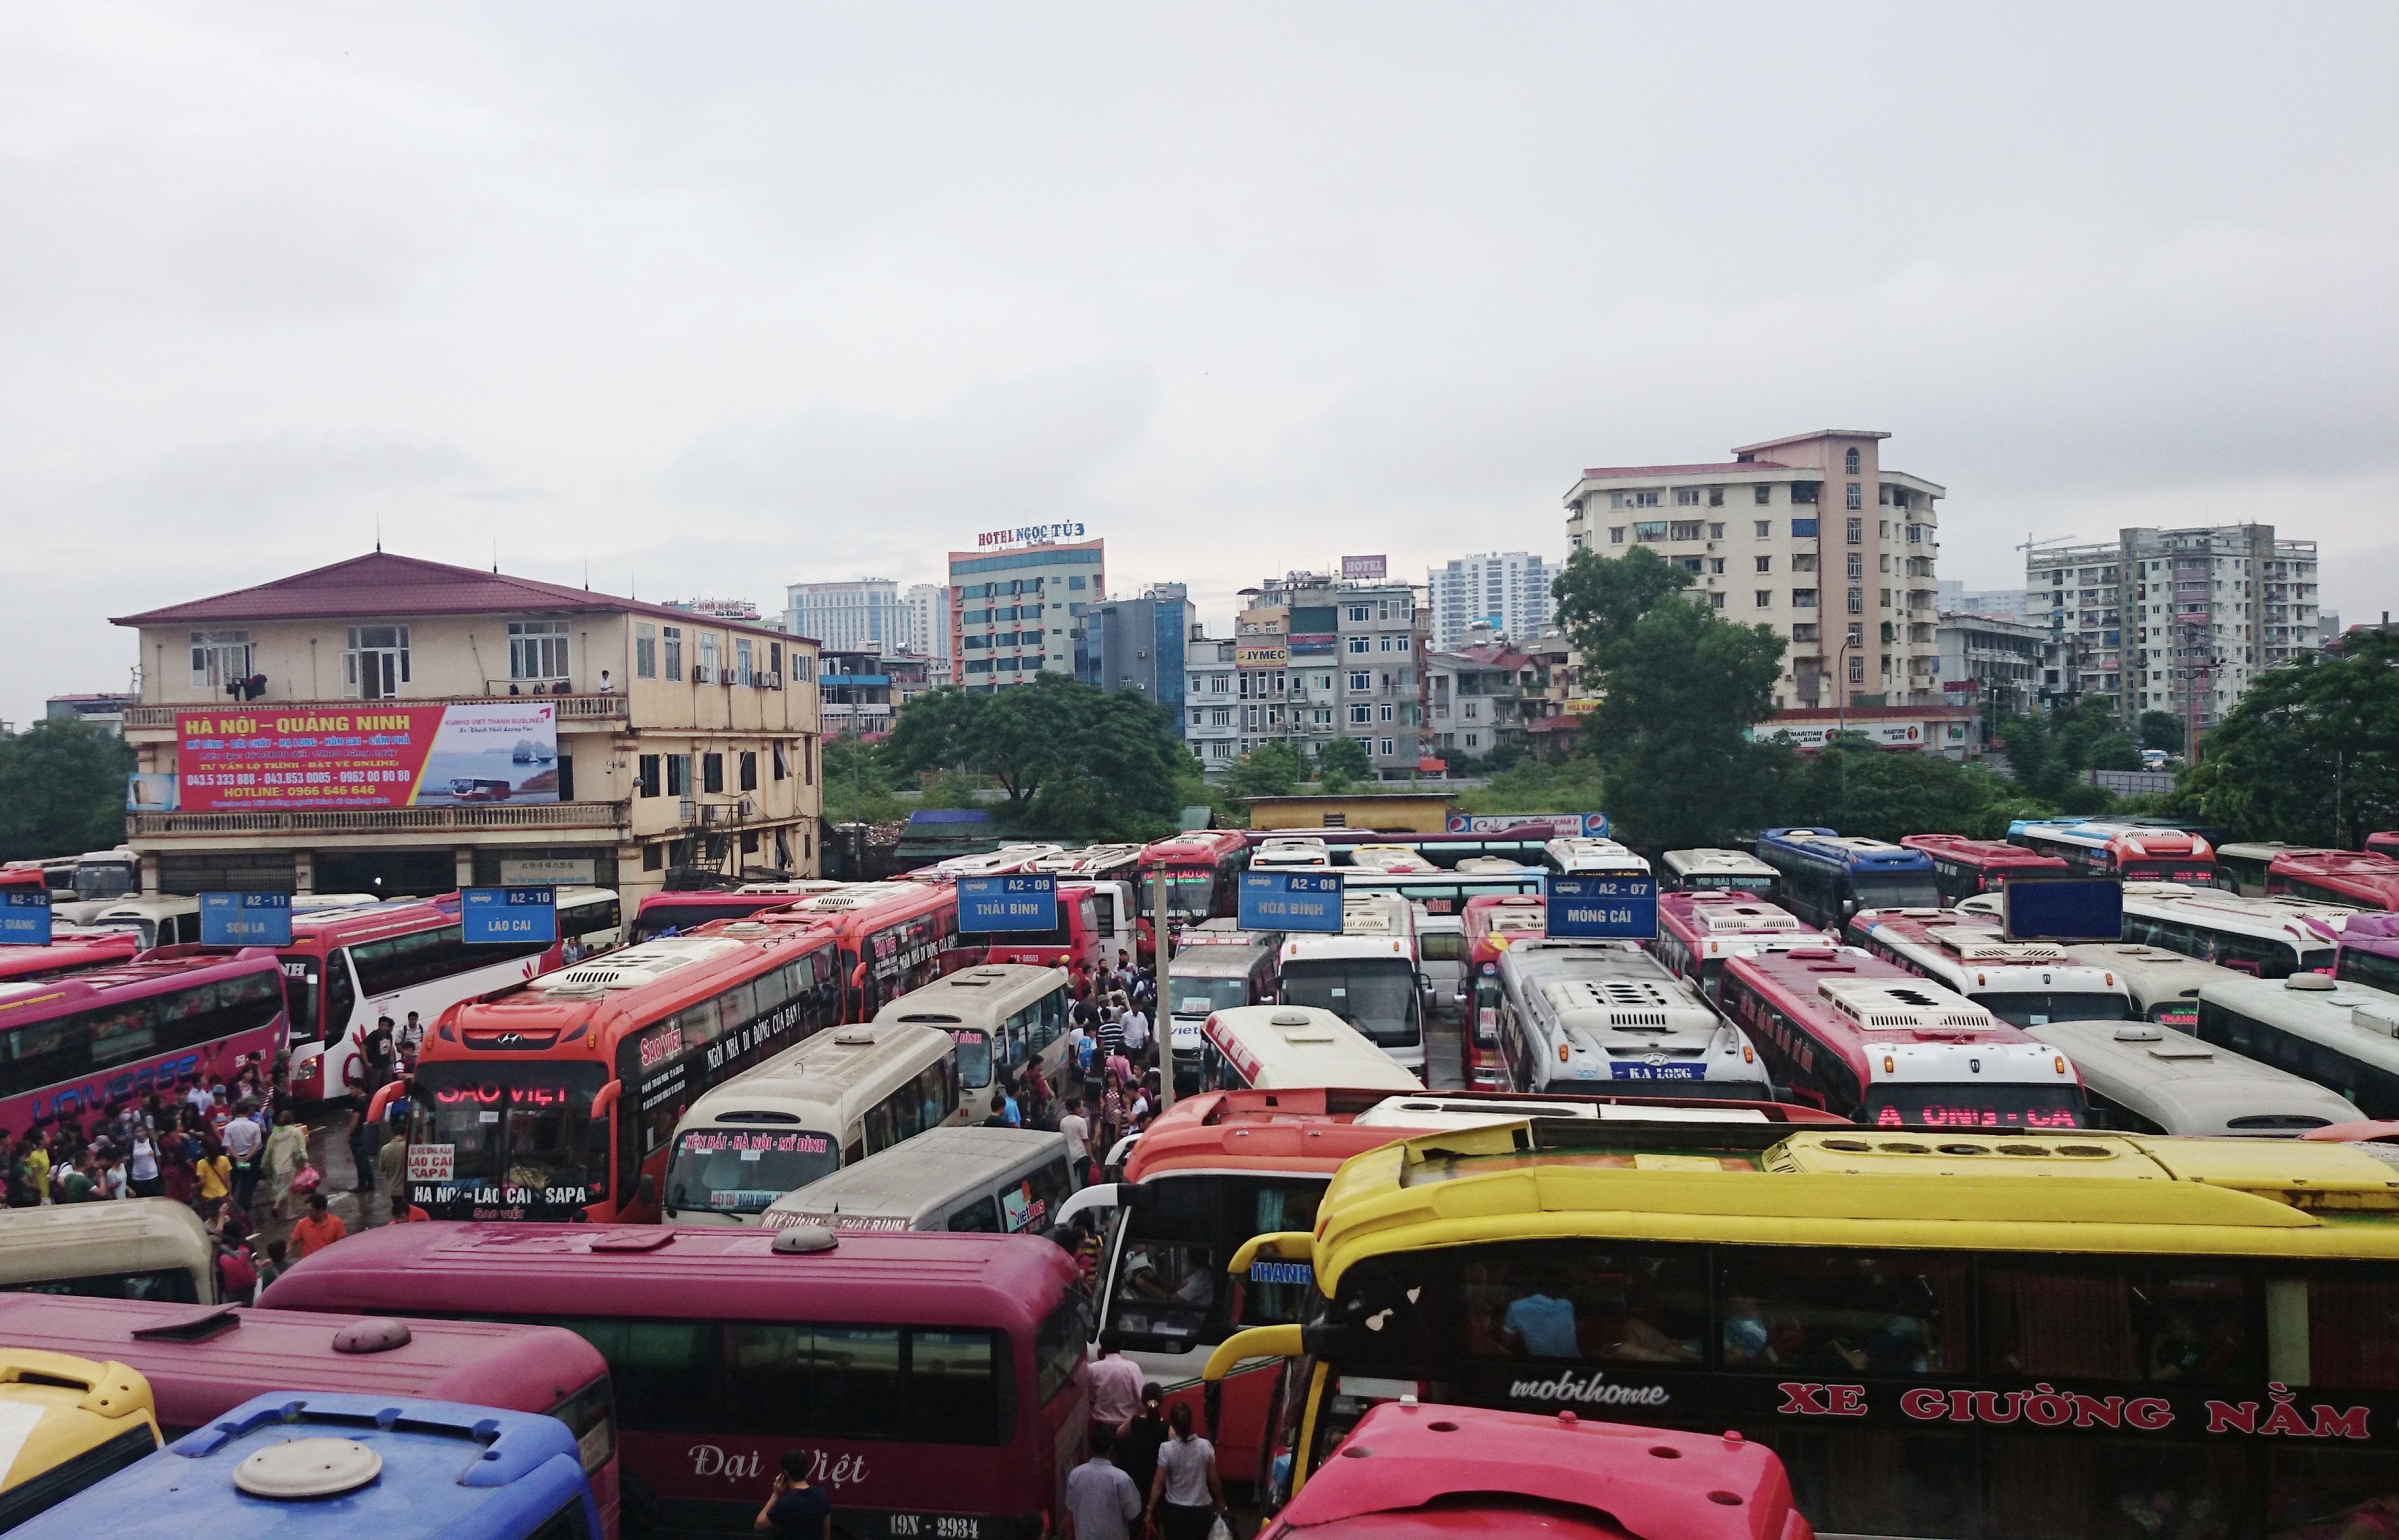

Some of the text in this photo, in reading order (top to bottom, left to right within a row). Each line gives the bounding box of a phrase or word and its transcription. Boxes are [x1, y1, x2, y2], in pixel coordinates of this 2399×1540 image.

[978, 530, 1014, 546] HOTEL
[1016, 525, 1048, 542] NGỌC
[1052, 519, 1073, 537] TÚ
[1346, 560, 1383, 572] HOTEL
[1247, 650, 1285, 660] JYMEC
[185, 712, 411, 737] HÀ NỘI QUẢNG NINH
[187, 774, 214, 786] 043.5
[216, 774, 235, 786] 333
[339, 771, 365, 783] 0962
[224, 785, 376, 798] HOTLINE: 0966 646 646
[1008, 879, 1050, 890] A2 09
[1291, 878, 1336, 890] A2 08
[1599, 883, 1647, 895] A2 07
[11, 894, 46, 905] A2 12
[247, 895, 285, 905] A2 11
[511, 892, 550, 903] A2 10
[976, 900, 1038, 915] THÁI BÌNH
[1290, 899, 1323, 915] BÌNH
[1567, 906, 1631, 923] MÓNG CÁI
[252, 923, 265, 933] LA
[488, 918, 531, 931] LÀO CAI
[707, 1042, 723, 1072] NGÔI
[726, 1030, 739, 1061] NHÀ
[742, 1029, 750, 1052] DI
[753, 1018, 770, 1047] ĐỘNG
[772, 1007, 785, 1034] CỦA
[641, 1038, 663, 1066] SAO
[1629, 1067, 1692, 1079] KA LONG
[685, 1131, 827, 1153] YÊN BÁI HÀ NỘI MỸ ĐÌNH
[432, 1156, 453, 1166] CAI
[411, 1168, 449, 1179] SAPA
[414, 1186, 586, 1203] HA LAO CAI SAPA
[1251, 1261, 1311, 1284] THANH
[1510, 1370, 1670, 1406] mobihome
[1777, 1382, 2370, 1439] XE GIƯỜNG NẰM
[688, 1444, 764, 1483] Đại
[890, 1514, 980, 1539] 19N 2934
